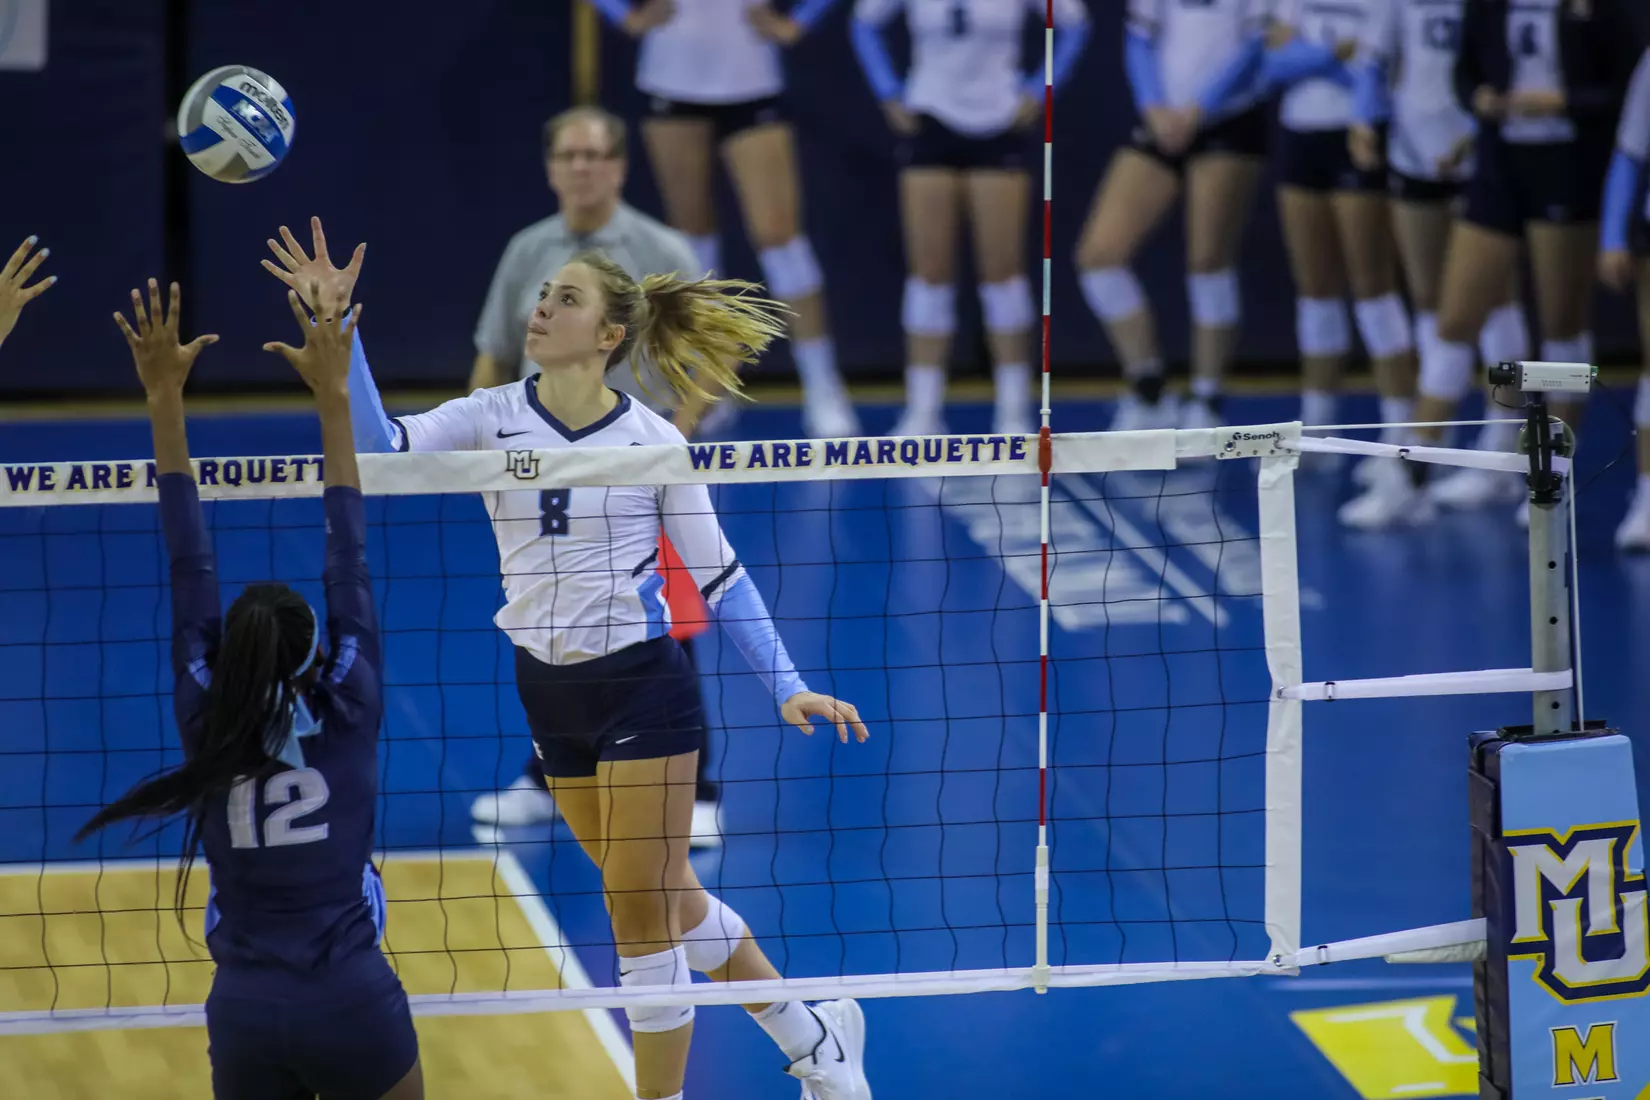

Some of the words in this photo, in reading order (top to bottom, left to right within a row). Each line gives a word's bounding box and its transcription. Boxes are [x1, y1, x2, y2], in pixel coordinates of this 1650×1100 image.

[240, 82, 290, 131] molten
[686, 444, 737, 470] WE
[747, 442, 812, 469] ARE
[823, 436, 1027, 467] MARQUETTE
[1243, 431, 1280, 441] Senoh
[4, 465, 57, 492] WE
[66, 463, 133, 490] ARE
[146, 457, 324, 487] RQUETT
[506, 450, 540, 480] MU
[540, 488, 572, 536] 8
[227, 767, 330, 848] 12
[1507, 837, 1650, 989] MU
[1551, 1022, 1620, 1087] M
